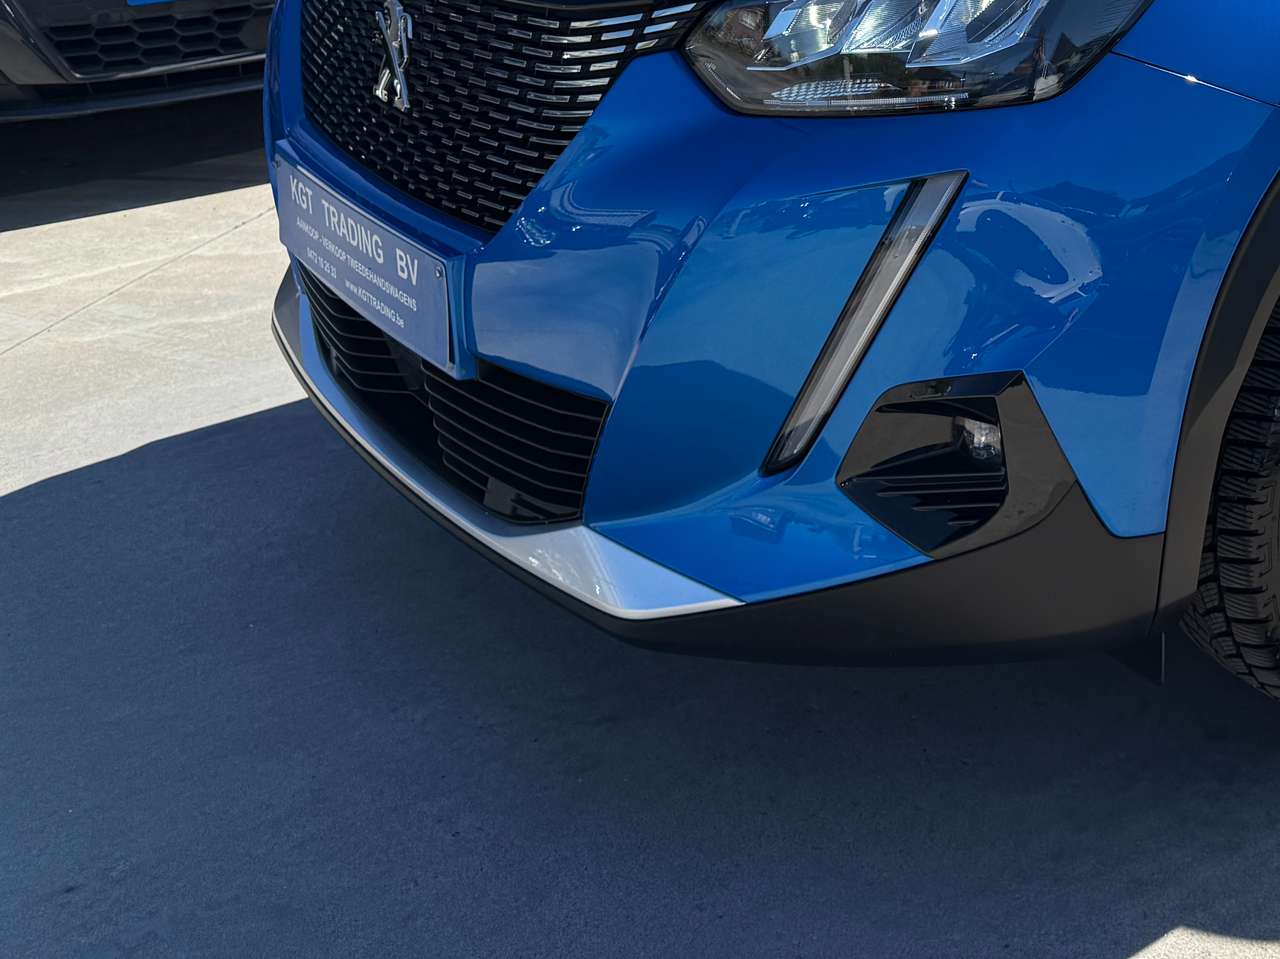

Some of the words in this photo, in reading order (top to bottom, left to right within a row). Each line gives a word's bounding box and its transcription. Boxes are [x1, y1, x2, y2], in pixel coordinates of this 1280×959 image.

[289, 174, 313, 214] KGT
[321, 199, 384, 264] TRADING
[396, 247, 418, 286] BV
[347, 254, 417, 312] TWEEDEHANDSWAGENS
